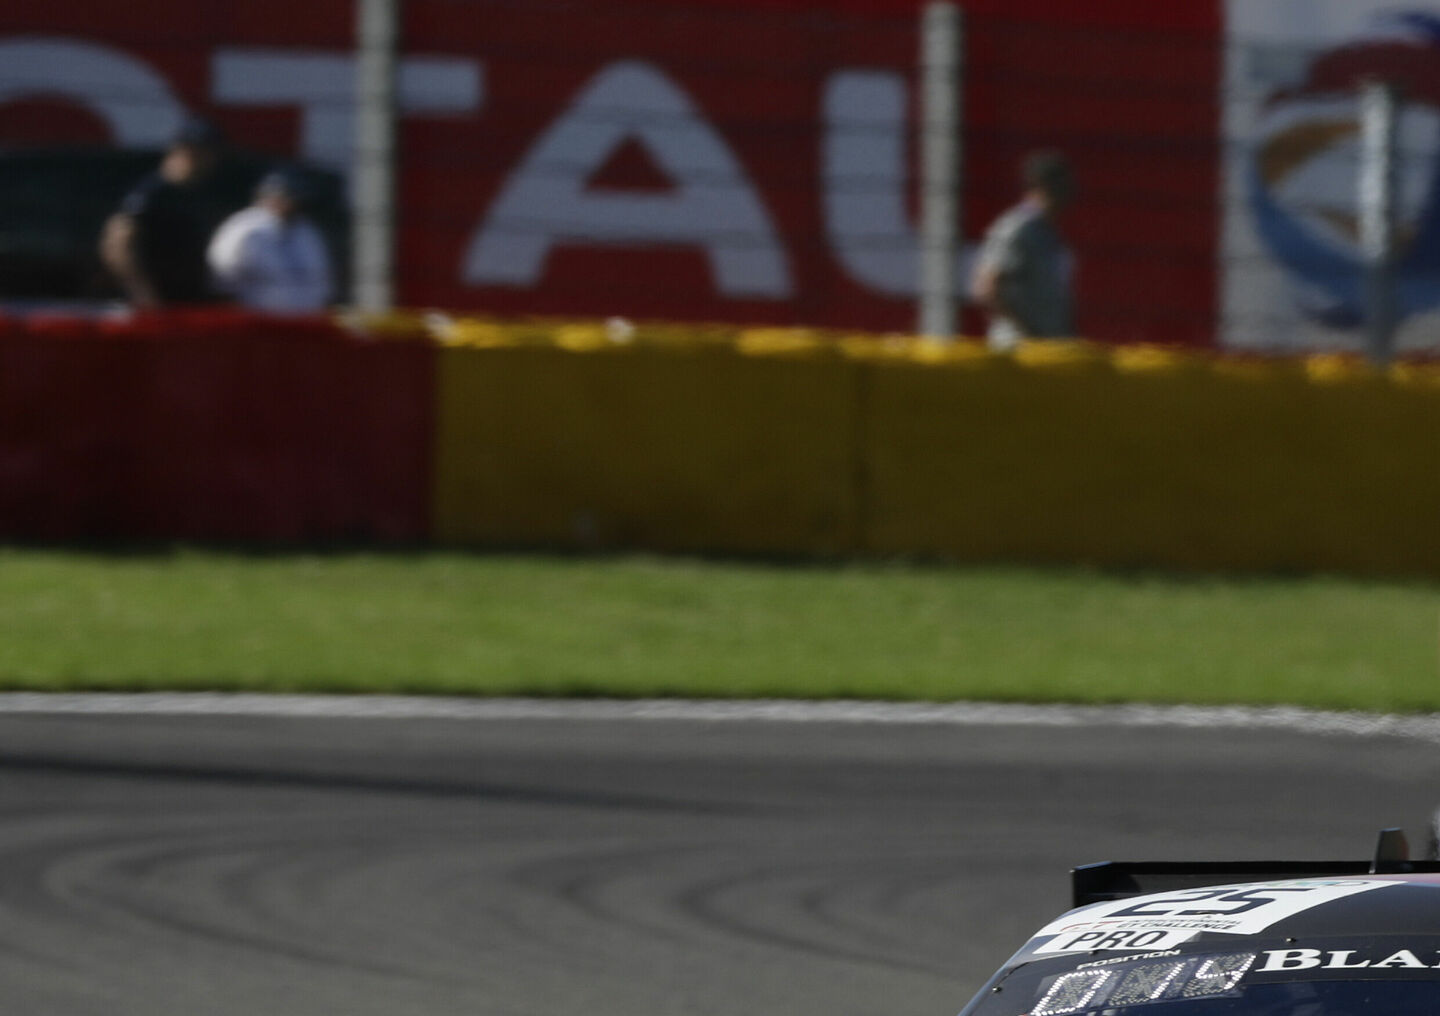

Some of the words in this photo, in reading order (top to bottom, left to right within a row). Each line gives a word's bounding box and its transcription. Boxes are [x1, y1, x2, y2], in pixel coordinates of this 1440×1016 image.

[1101, 887, 1315, 918] 25
[1060, 930, 1169, 949] PRO
[1076, 949, 1182, 969] POSITION
